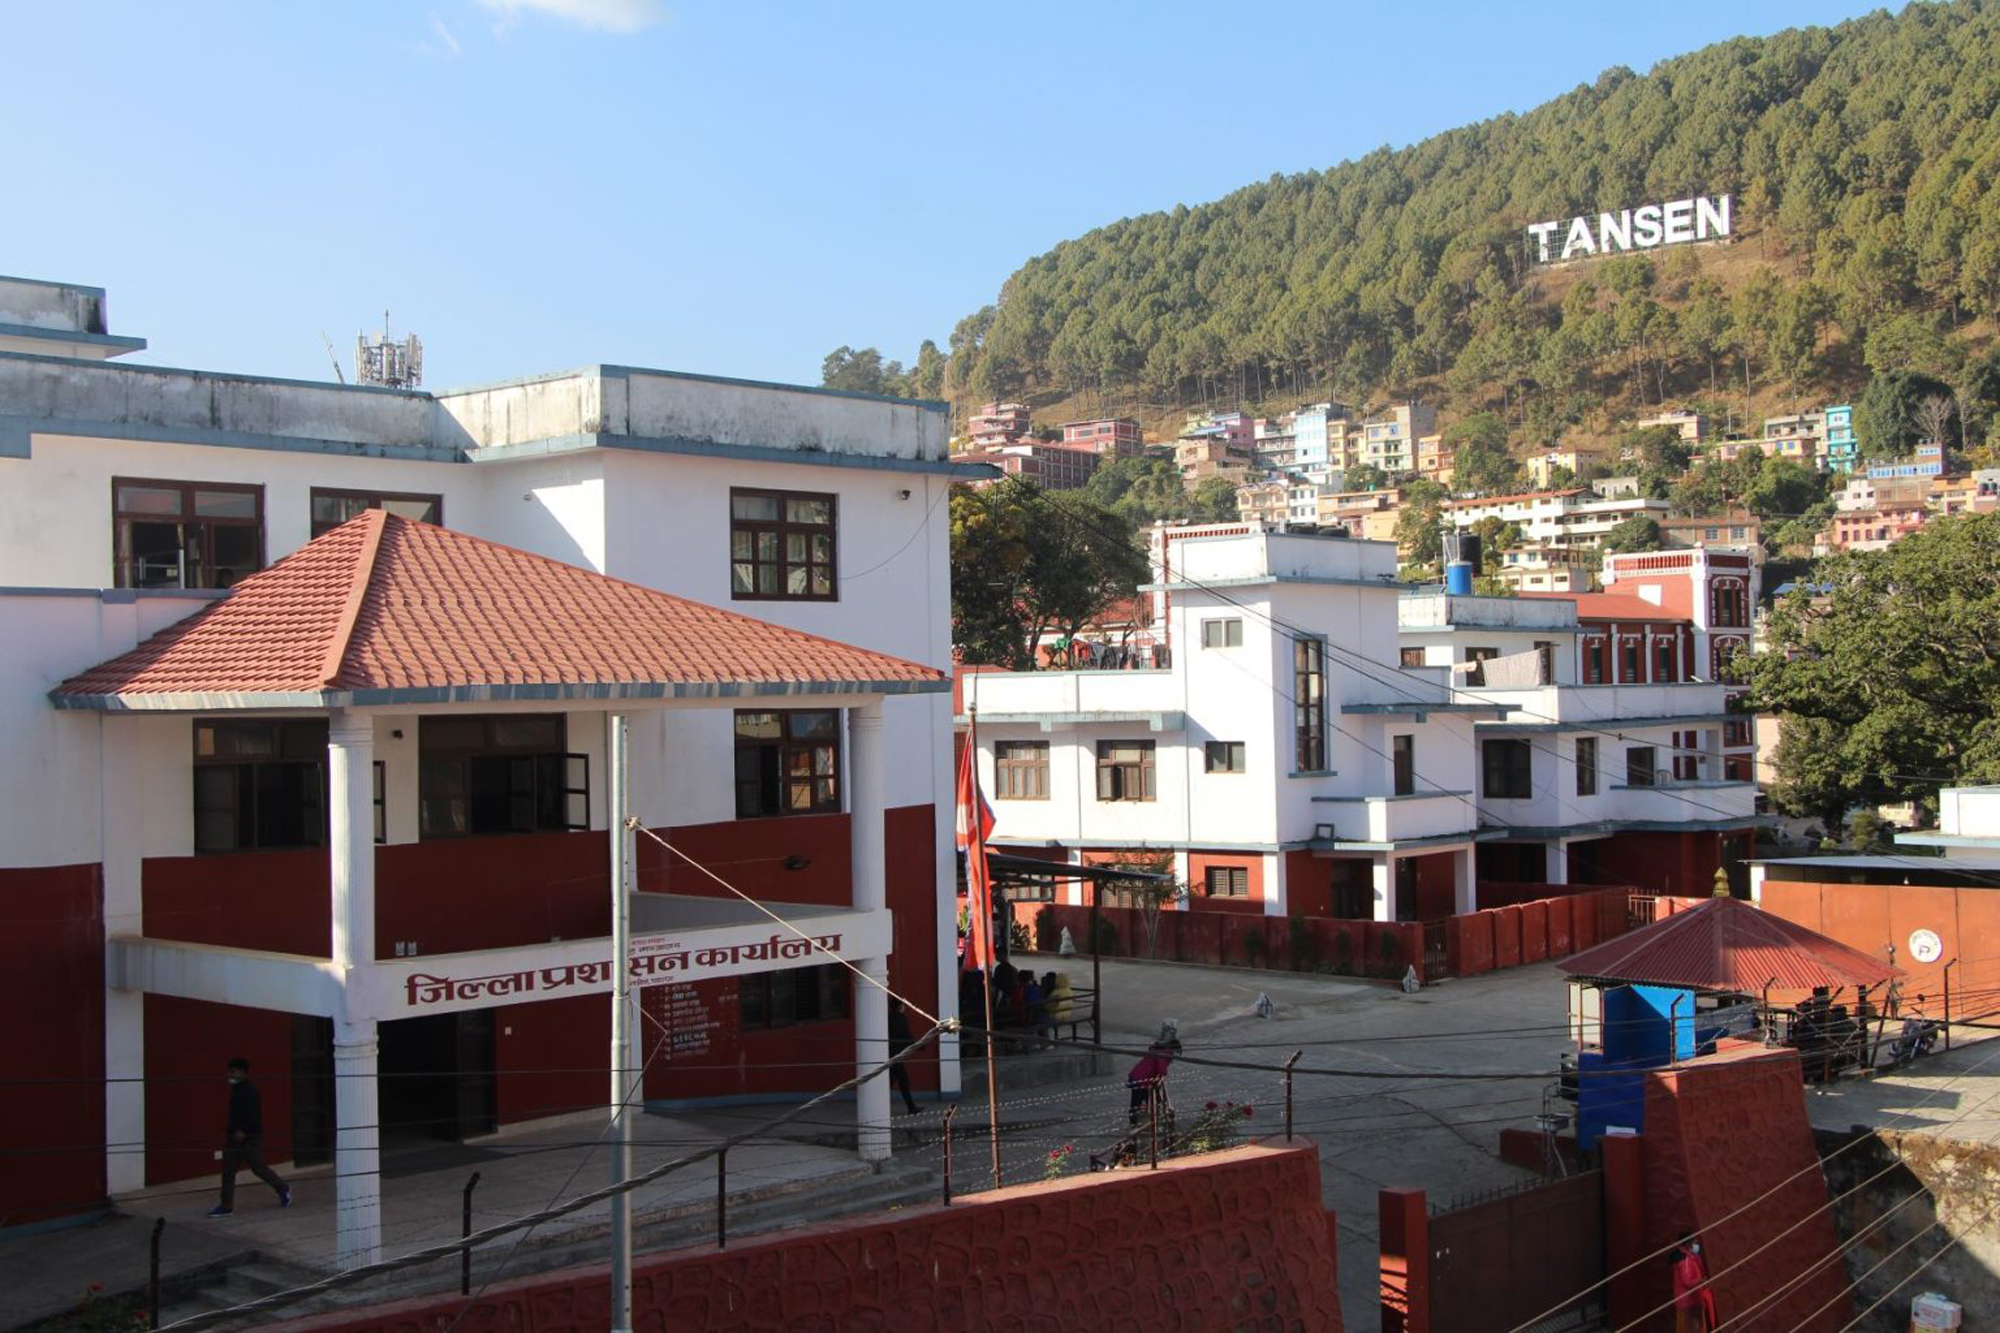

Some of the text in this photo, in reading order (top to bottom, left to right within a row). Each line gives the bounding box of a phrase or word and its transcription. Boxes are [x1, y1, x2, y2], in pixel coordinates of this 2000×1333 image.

[1528, 194, 1730, 262] TANSEN
[404, 971, 537, 1006] जिल्ला
[695, 933, 843, 967] कार्यालय
